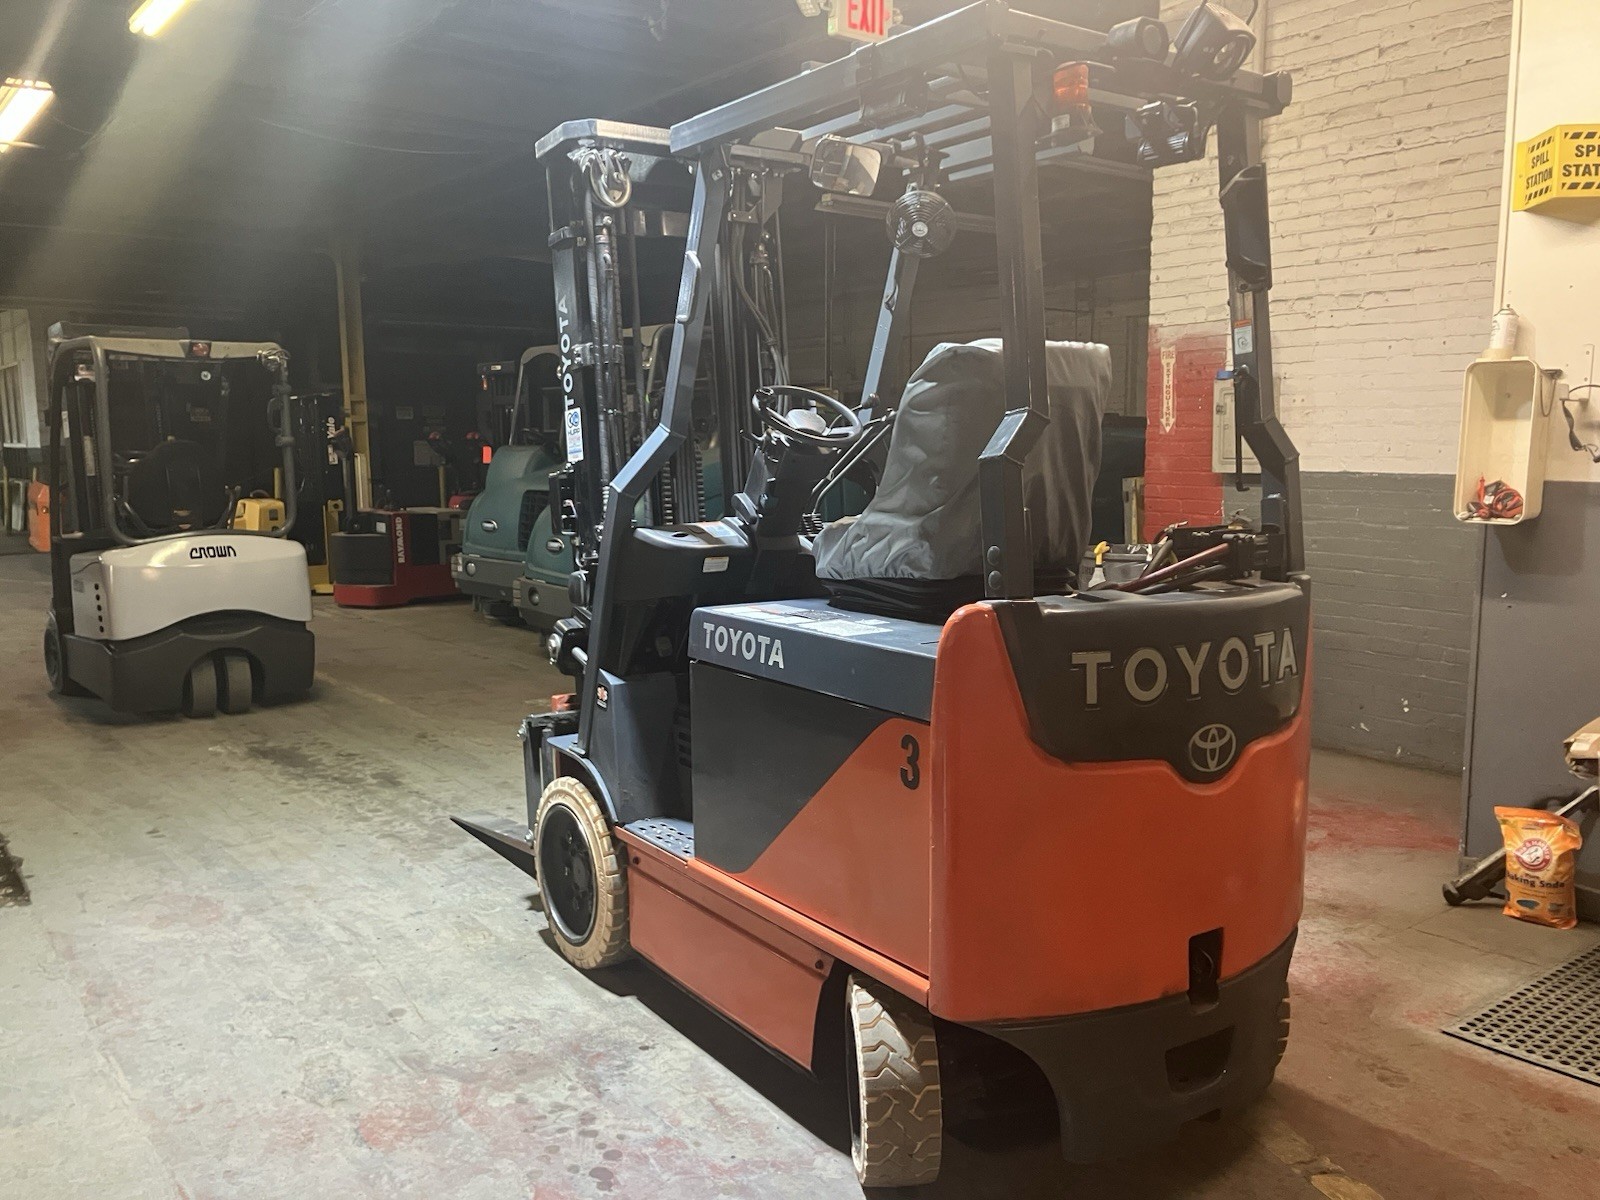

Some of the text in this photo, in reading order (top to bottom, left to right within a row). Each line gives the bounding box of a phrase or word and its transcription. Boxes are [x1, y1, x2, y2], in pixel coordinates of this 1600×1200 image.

[1526, 167, 1553, 189] STATION
[1531, 151, 1549, 169] SPILL
[558, 294, 575, 411] TOYOTA
[1162, 350, 1175, 360] FIRE
[395, 516, 406, 563] RAYMOND
[703, 621, 785, 670] TOYOTA
[1071, 627, 1299, 707] TOYOTA
[900, 733, 921, 791] 3
[1539, 880, 1566, 889] Soda
